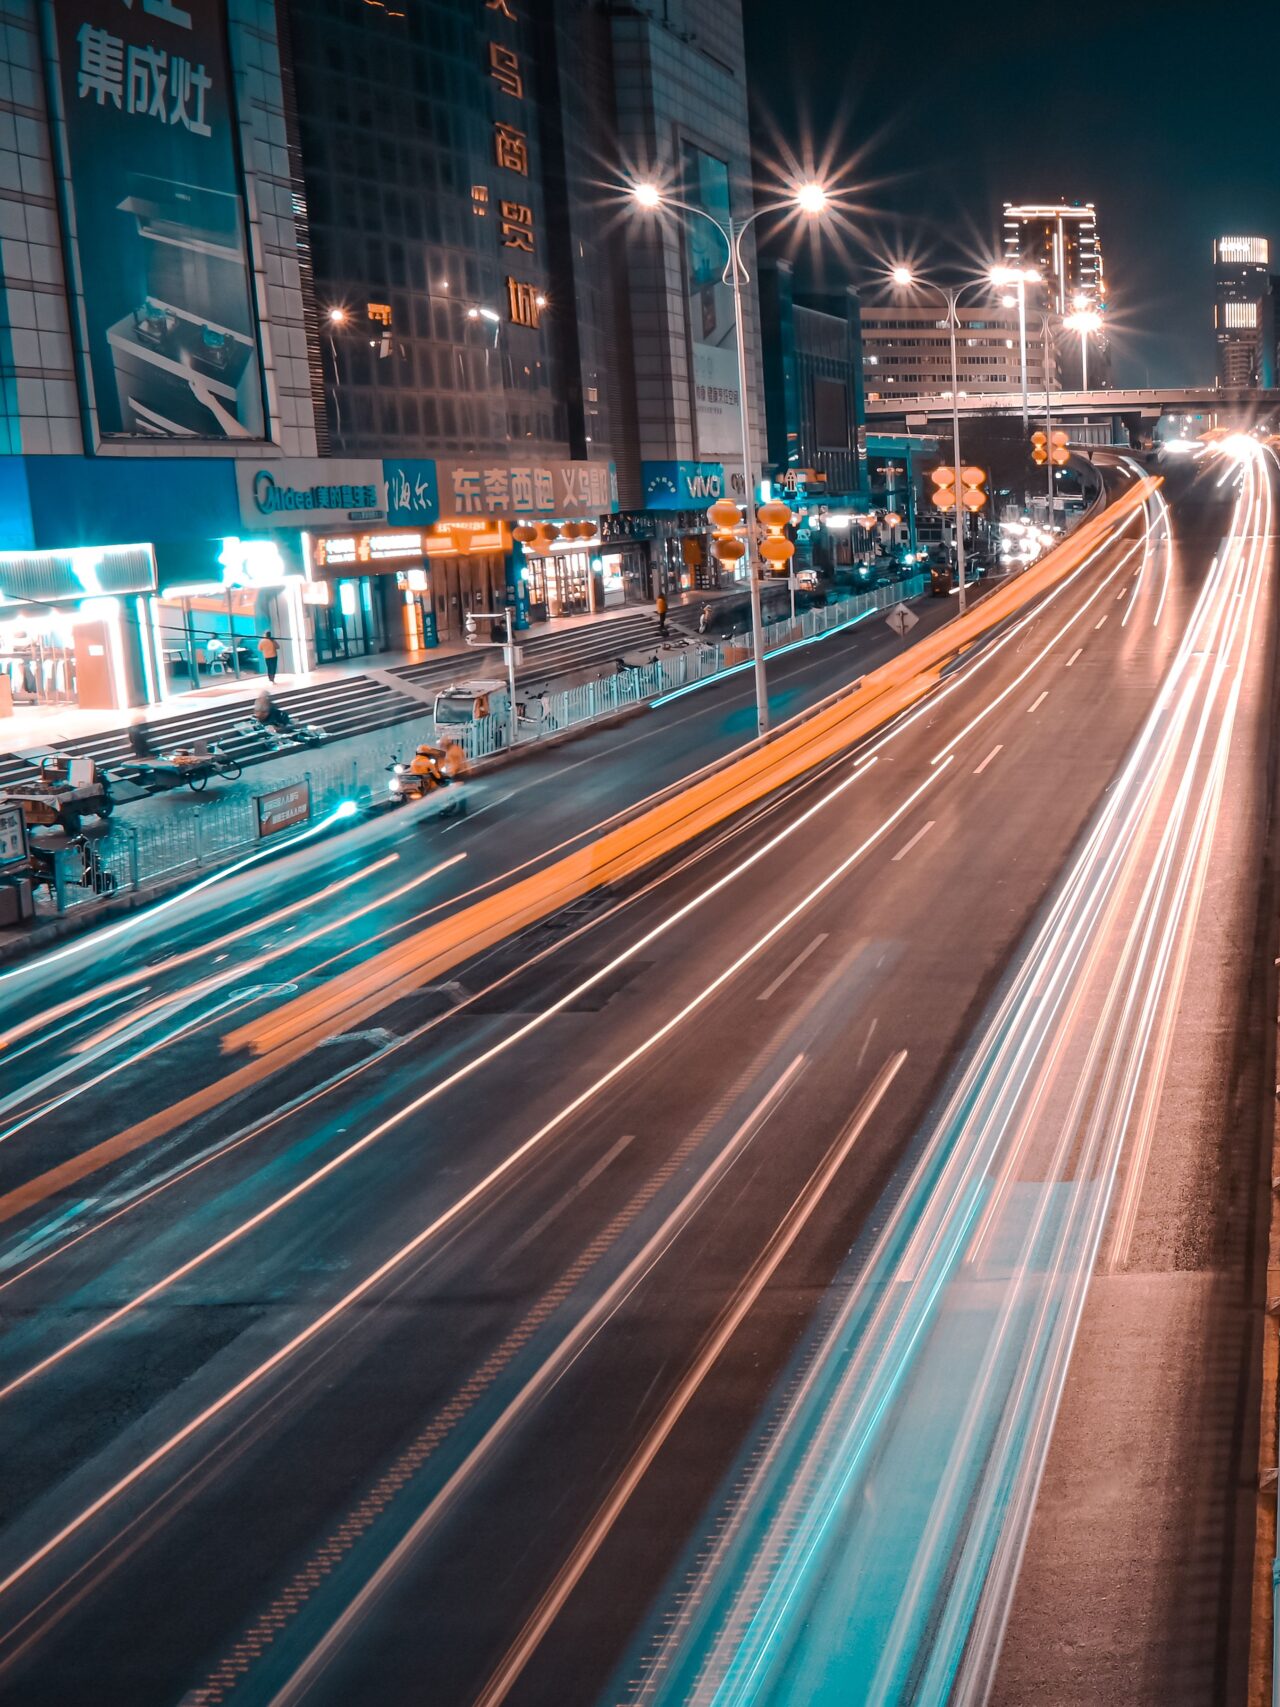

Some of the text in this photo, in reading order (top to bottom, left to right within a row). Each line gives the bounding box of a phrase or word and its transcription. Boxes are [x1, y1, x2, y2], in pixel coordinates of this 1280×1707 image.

[77, 22, 212, 137] 集成灶
[452, 468, 555, 512] 东奔西跑
